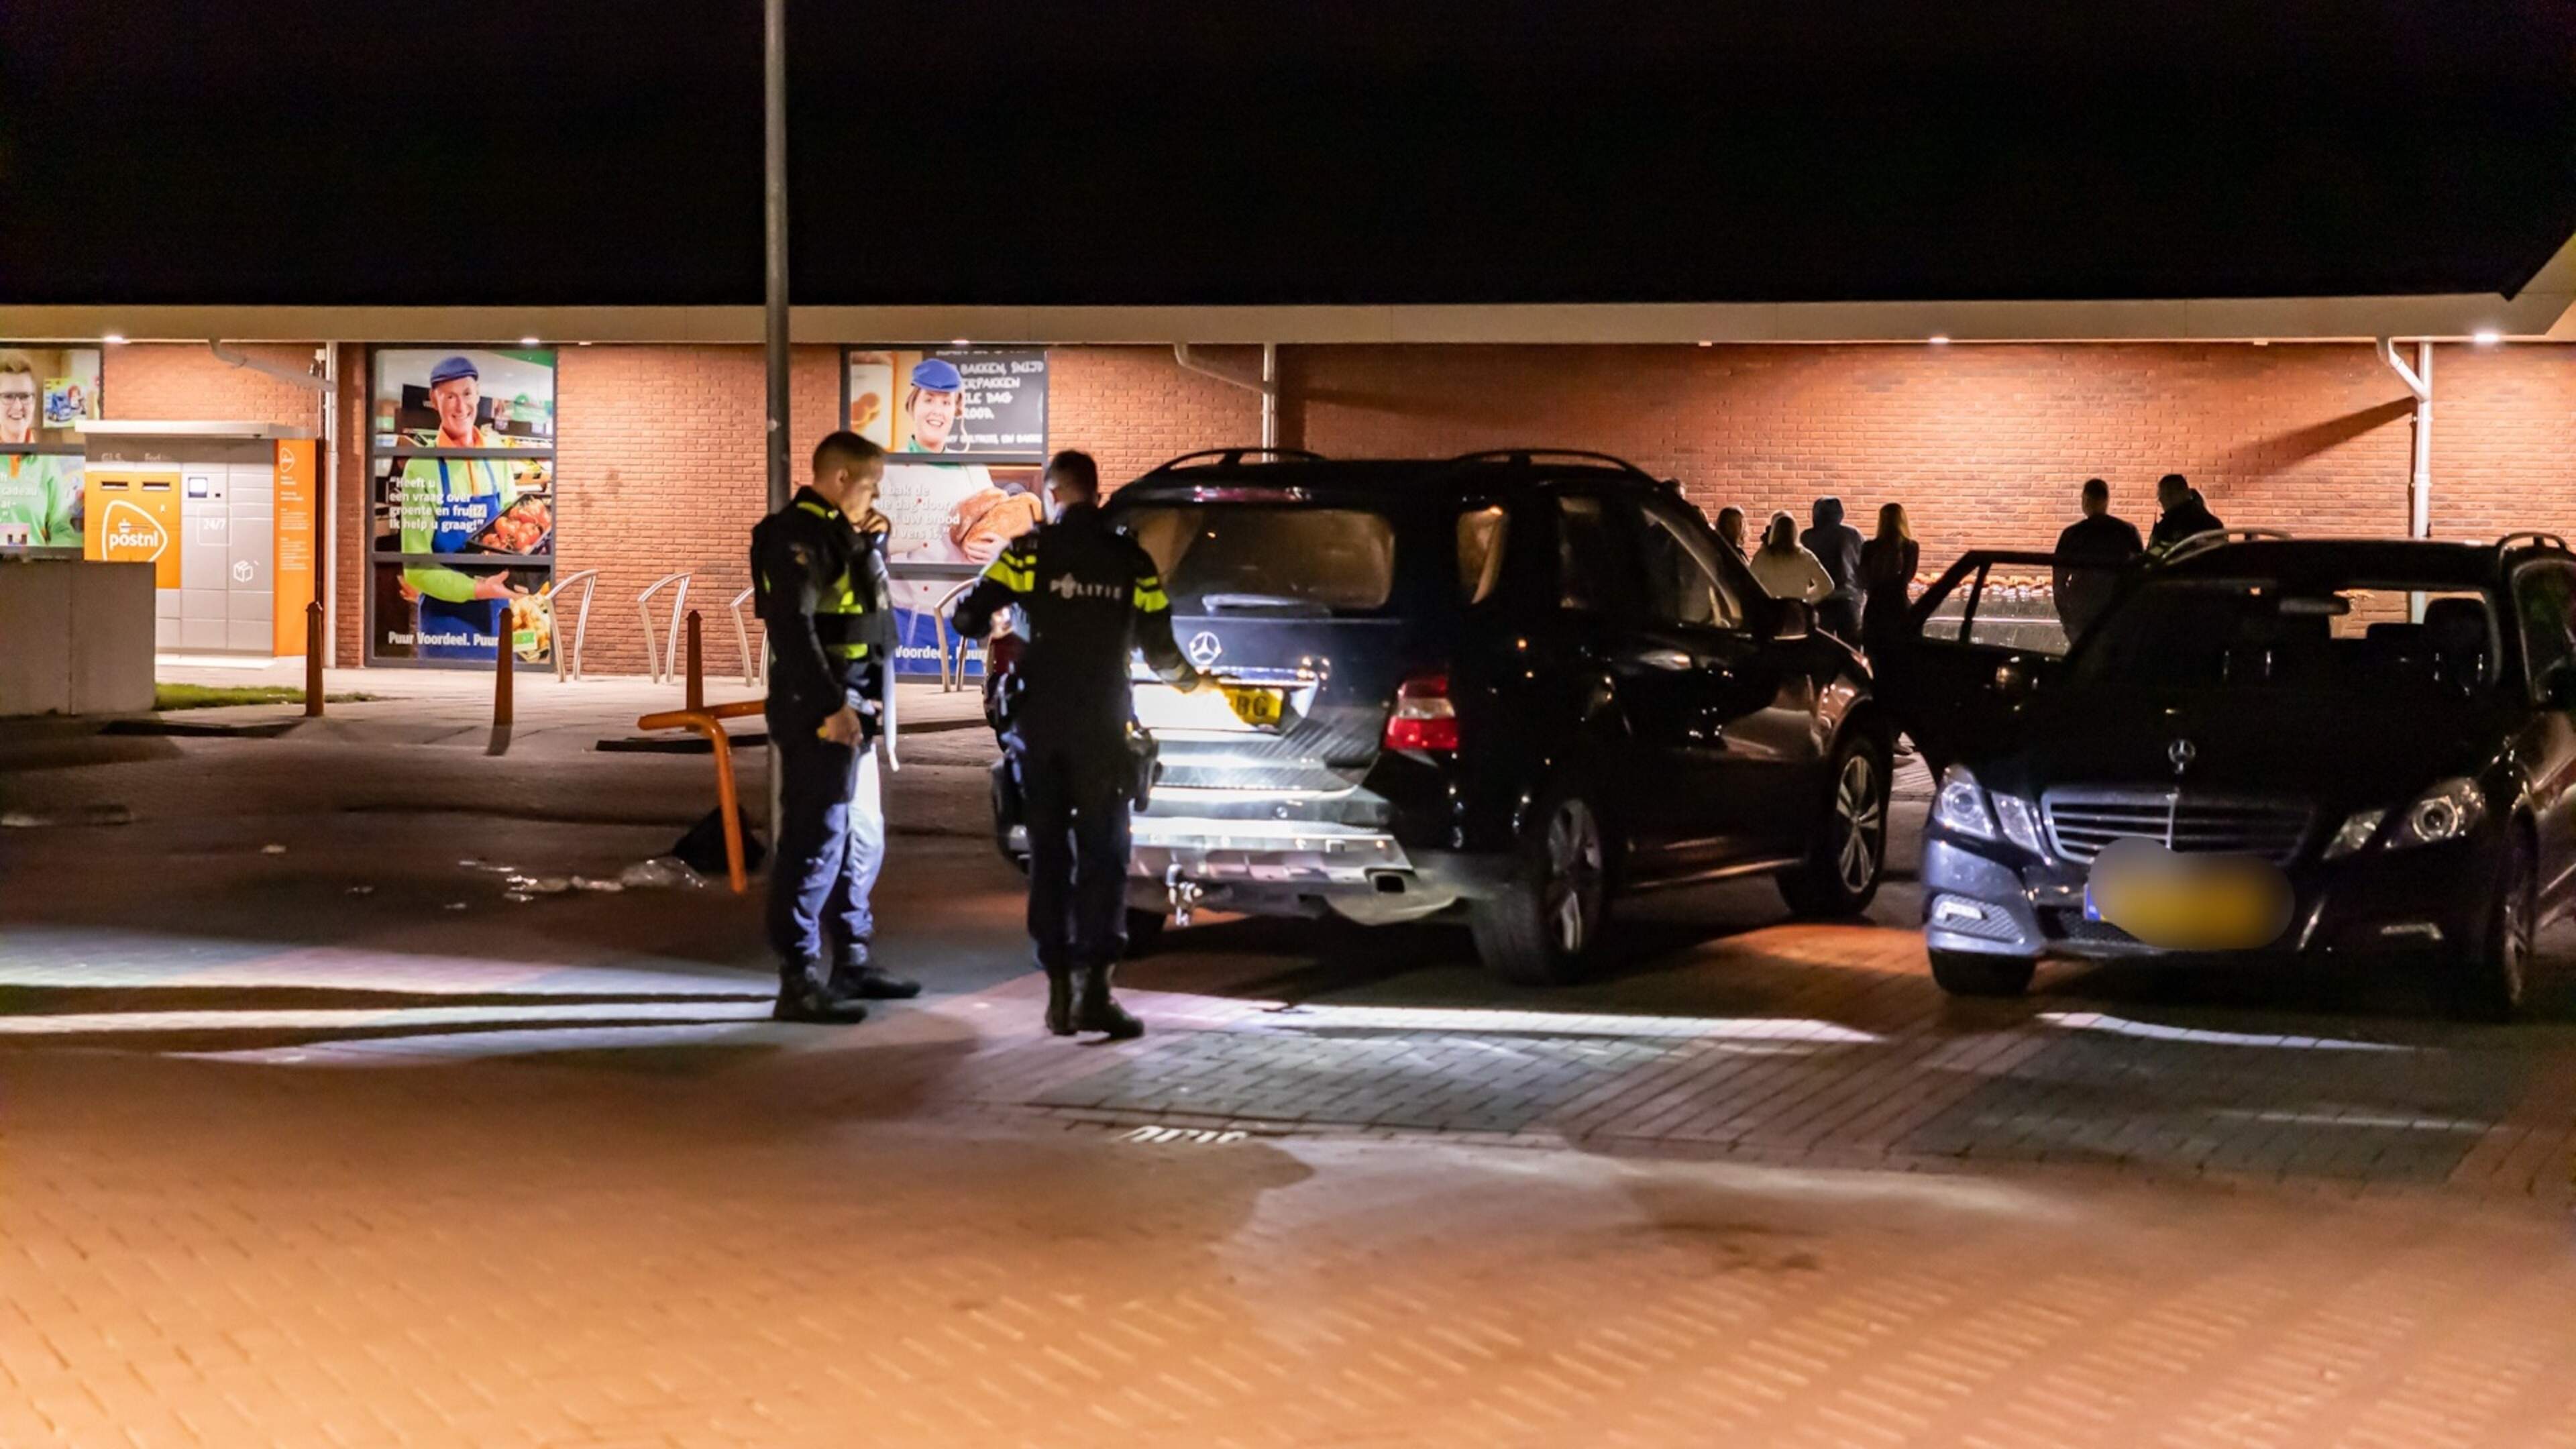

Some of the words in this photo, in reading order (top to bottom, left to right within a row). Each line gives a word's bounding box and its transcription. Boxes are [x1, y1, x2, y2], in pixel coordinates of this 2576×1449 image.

[962, 377, 1020, 389] ERPAKKEN
[915, 484, 930, 495] de
[389, 494, 409, 502] een
[413, 493, 444, 505] vraag
[446, 494, 471, 502] over
[896, 498, 918, 513] dag
[390, 506, 433, 519] groente
[437, 507, 449, 516] en
[203, 519, 228, 530] 24/7
[390, 519, 400, 529] Ik
[403, 519, 427, 531] help
[388, 632, 413, 645] Puur
[417, 632, 470, 645] Voordeel.
[896, 645, 953, 660] Voordee.
